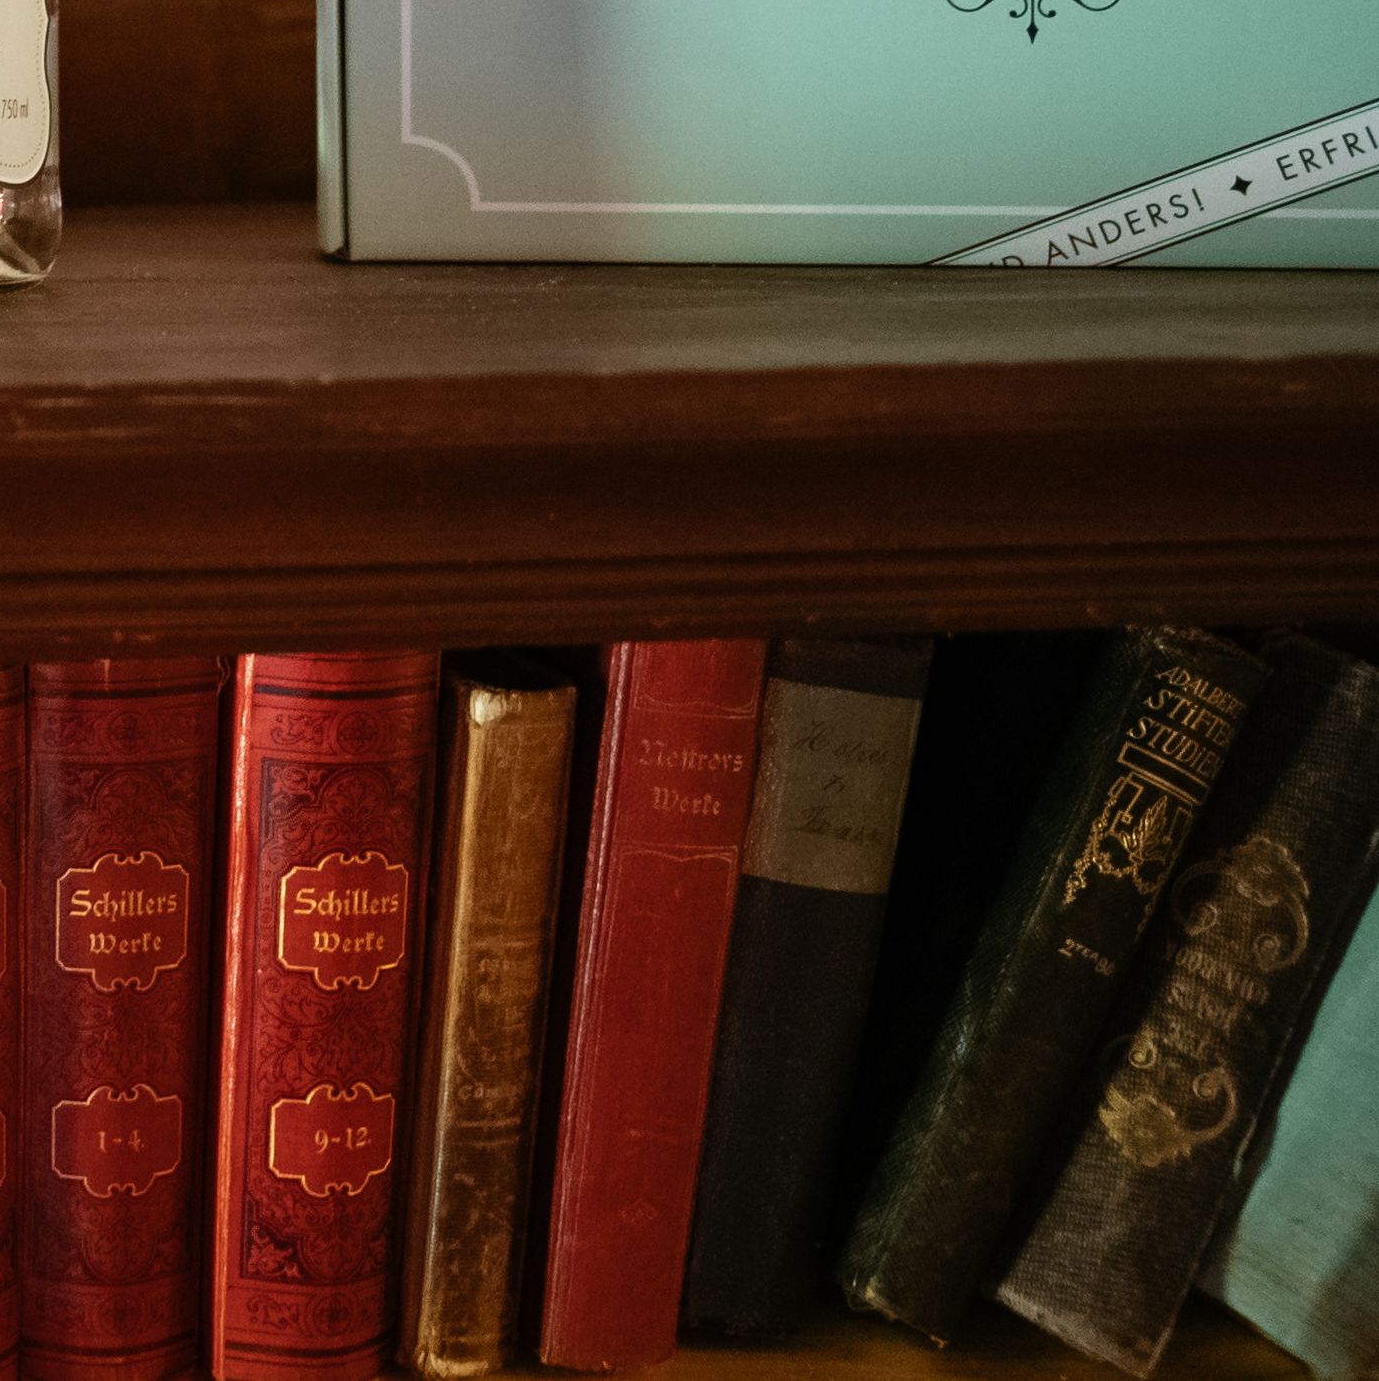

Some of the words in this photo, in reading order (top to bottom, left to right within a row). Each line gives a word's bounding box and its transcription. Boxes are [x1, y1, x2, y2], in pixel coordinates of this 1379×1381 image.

[0, 100, 19, 120] 750
[19, 98, 30, 119] ml
[1046, 187, 1206, 266] ANDERS!
[69, 890, 179, 923] Schillers
[292, 888, 401, 921] Schillers
[88, 929, 163, 956] Werke
[312, 929, 387, 956] Werke
